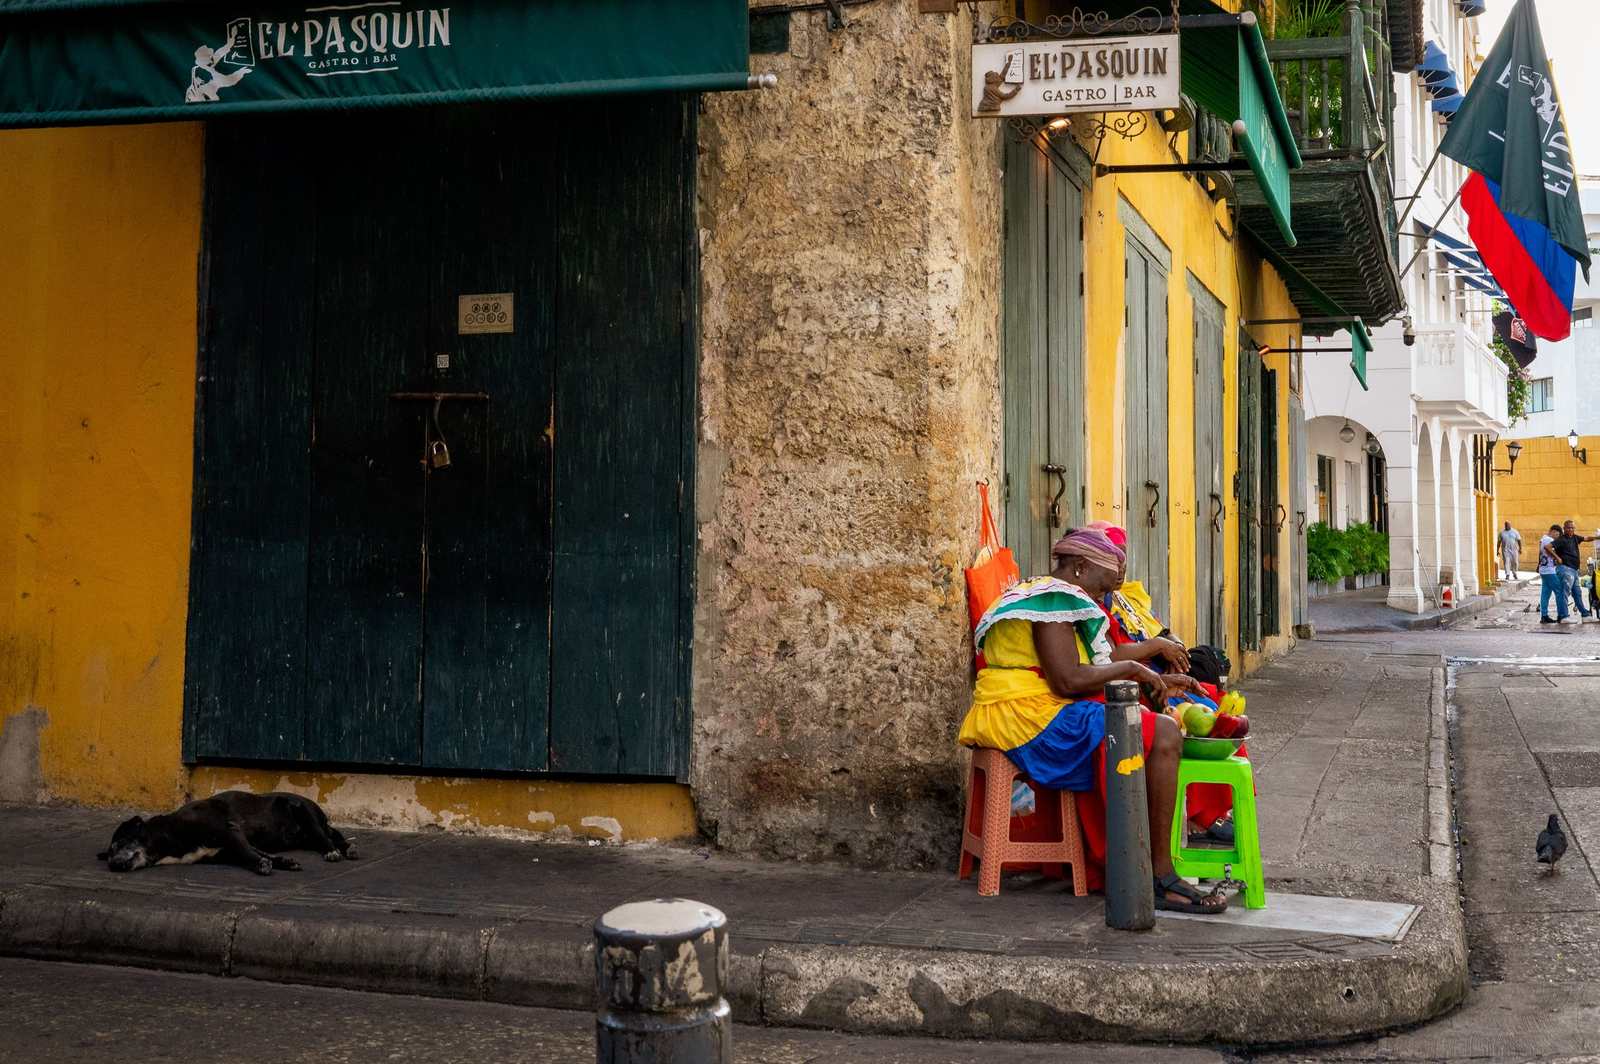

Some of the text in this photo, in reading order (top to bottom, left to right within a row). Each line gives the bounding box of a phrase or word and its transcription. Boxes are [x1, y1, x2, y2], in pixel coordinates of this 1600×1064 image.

[308, 54, 398, 69] GASTRO BAR
[1042, 85, 1157, 102] GASTRO BAR
